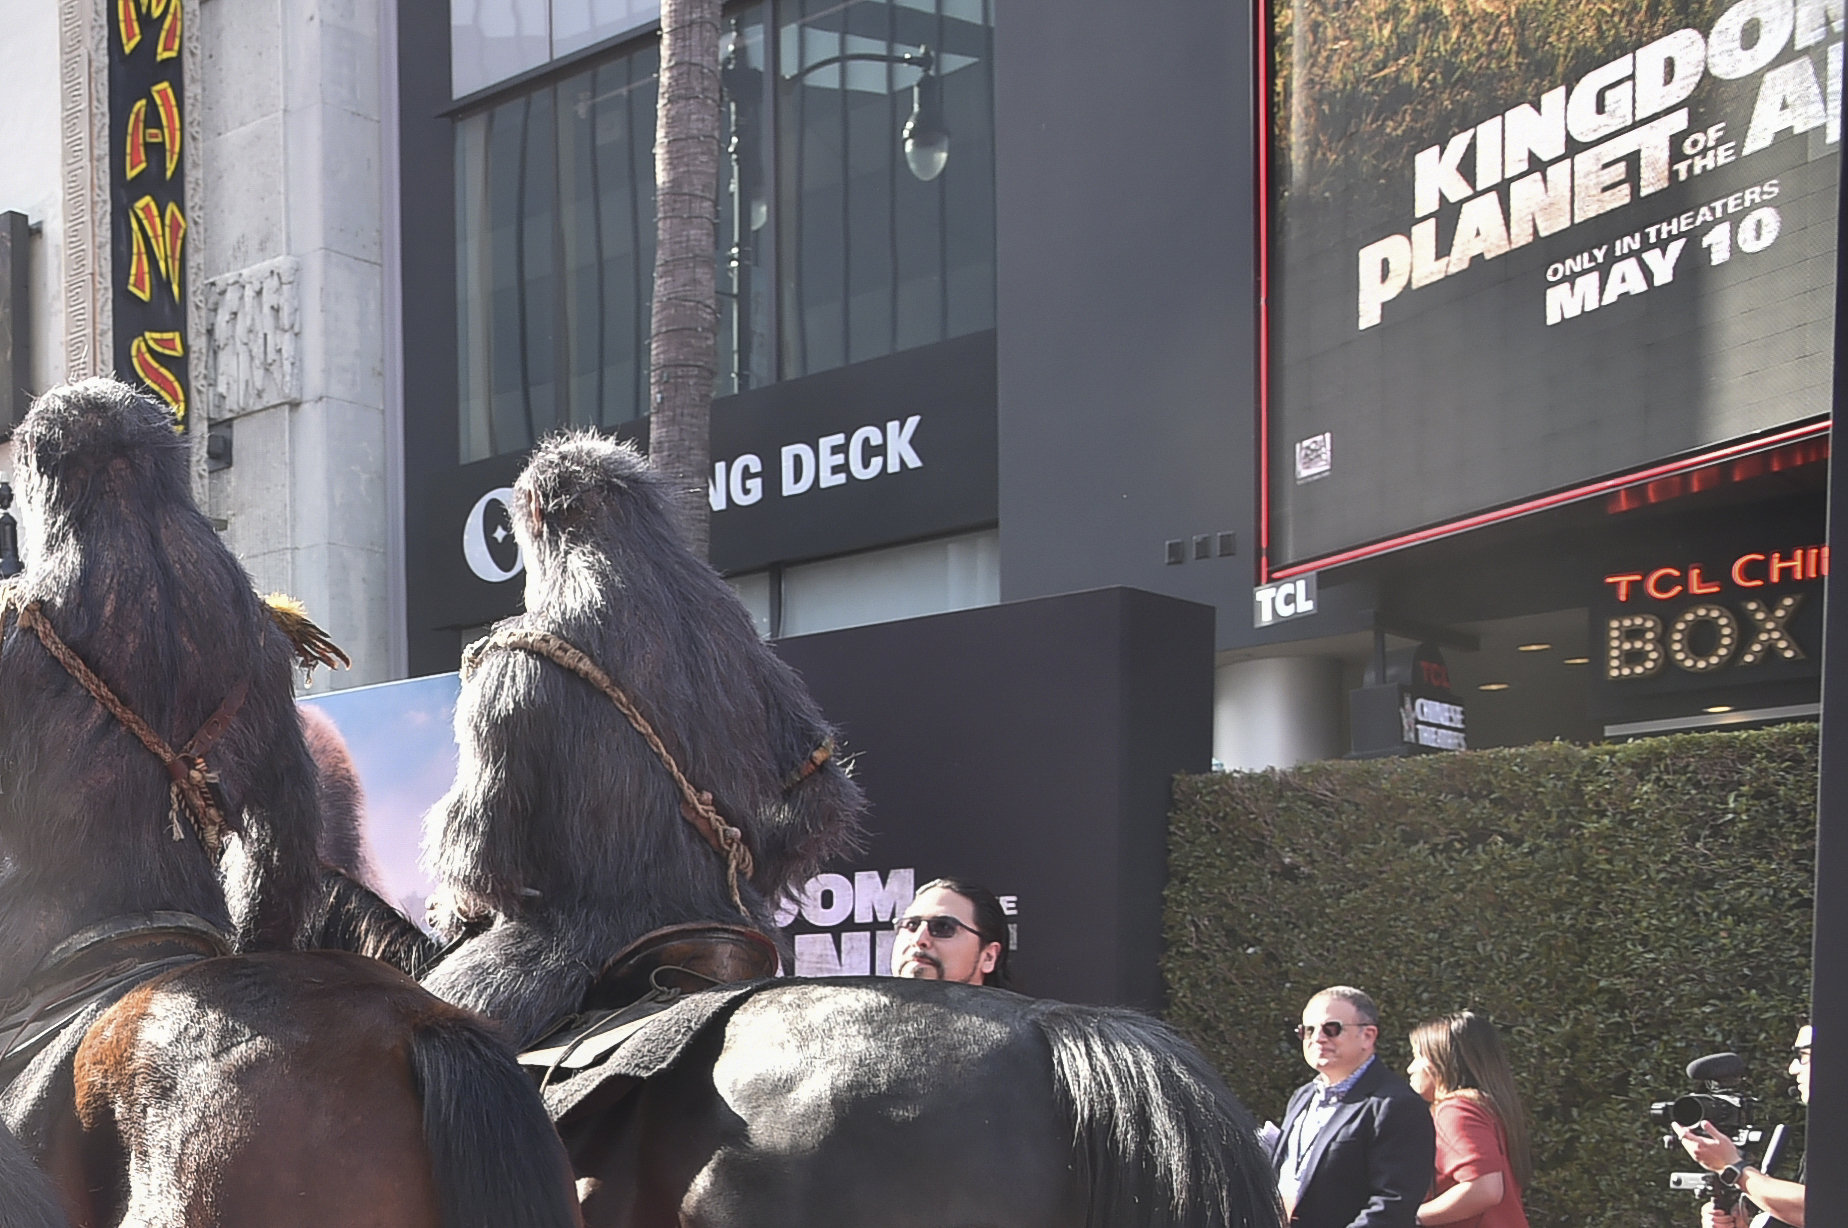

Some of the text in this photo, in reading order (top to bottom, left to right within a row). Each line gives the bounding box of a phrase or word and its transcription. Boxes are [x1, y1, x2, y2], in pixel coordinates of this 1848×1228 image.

[1358, 41, 1842, 330] PLANET OF THE A
[1546, 180, 1780, 281] ONLY IN THEATERS
[1546, 206, 1782, 325] MAY 10
[781, 415, 923, 496] DECK
[1256, 581, 1313, 622] TCL
[1604, 563, 1720, 602] TCL
[1608, 594, 1805, 680] BOX
